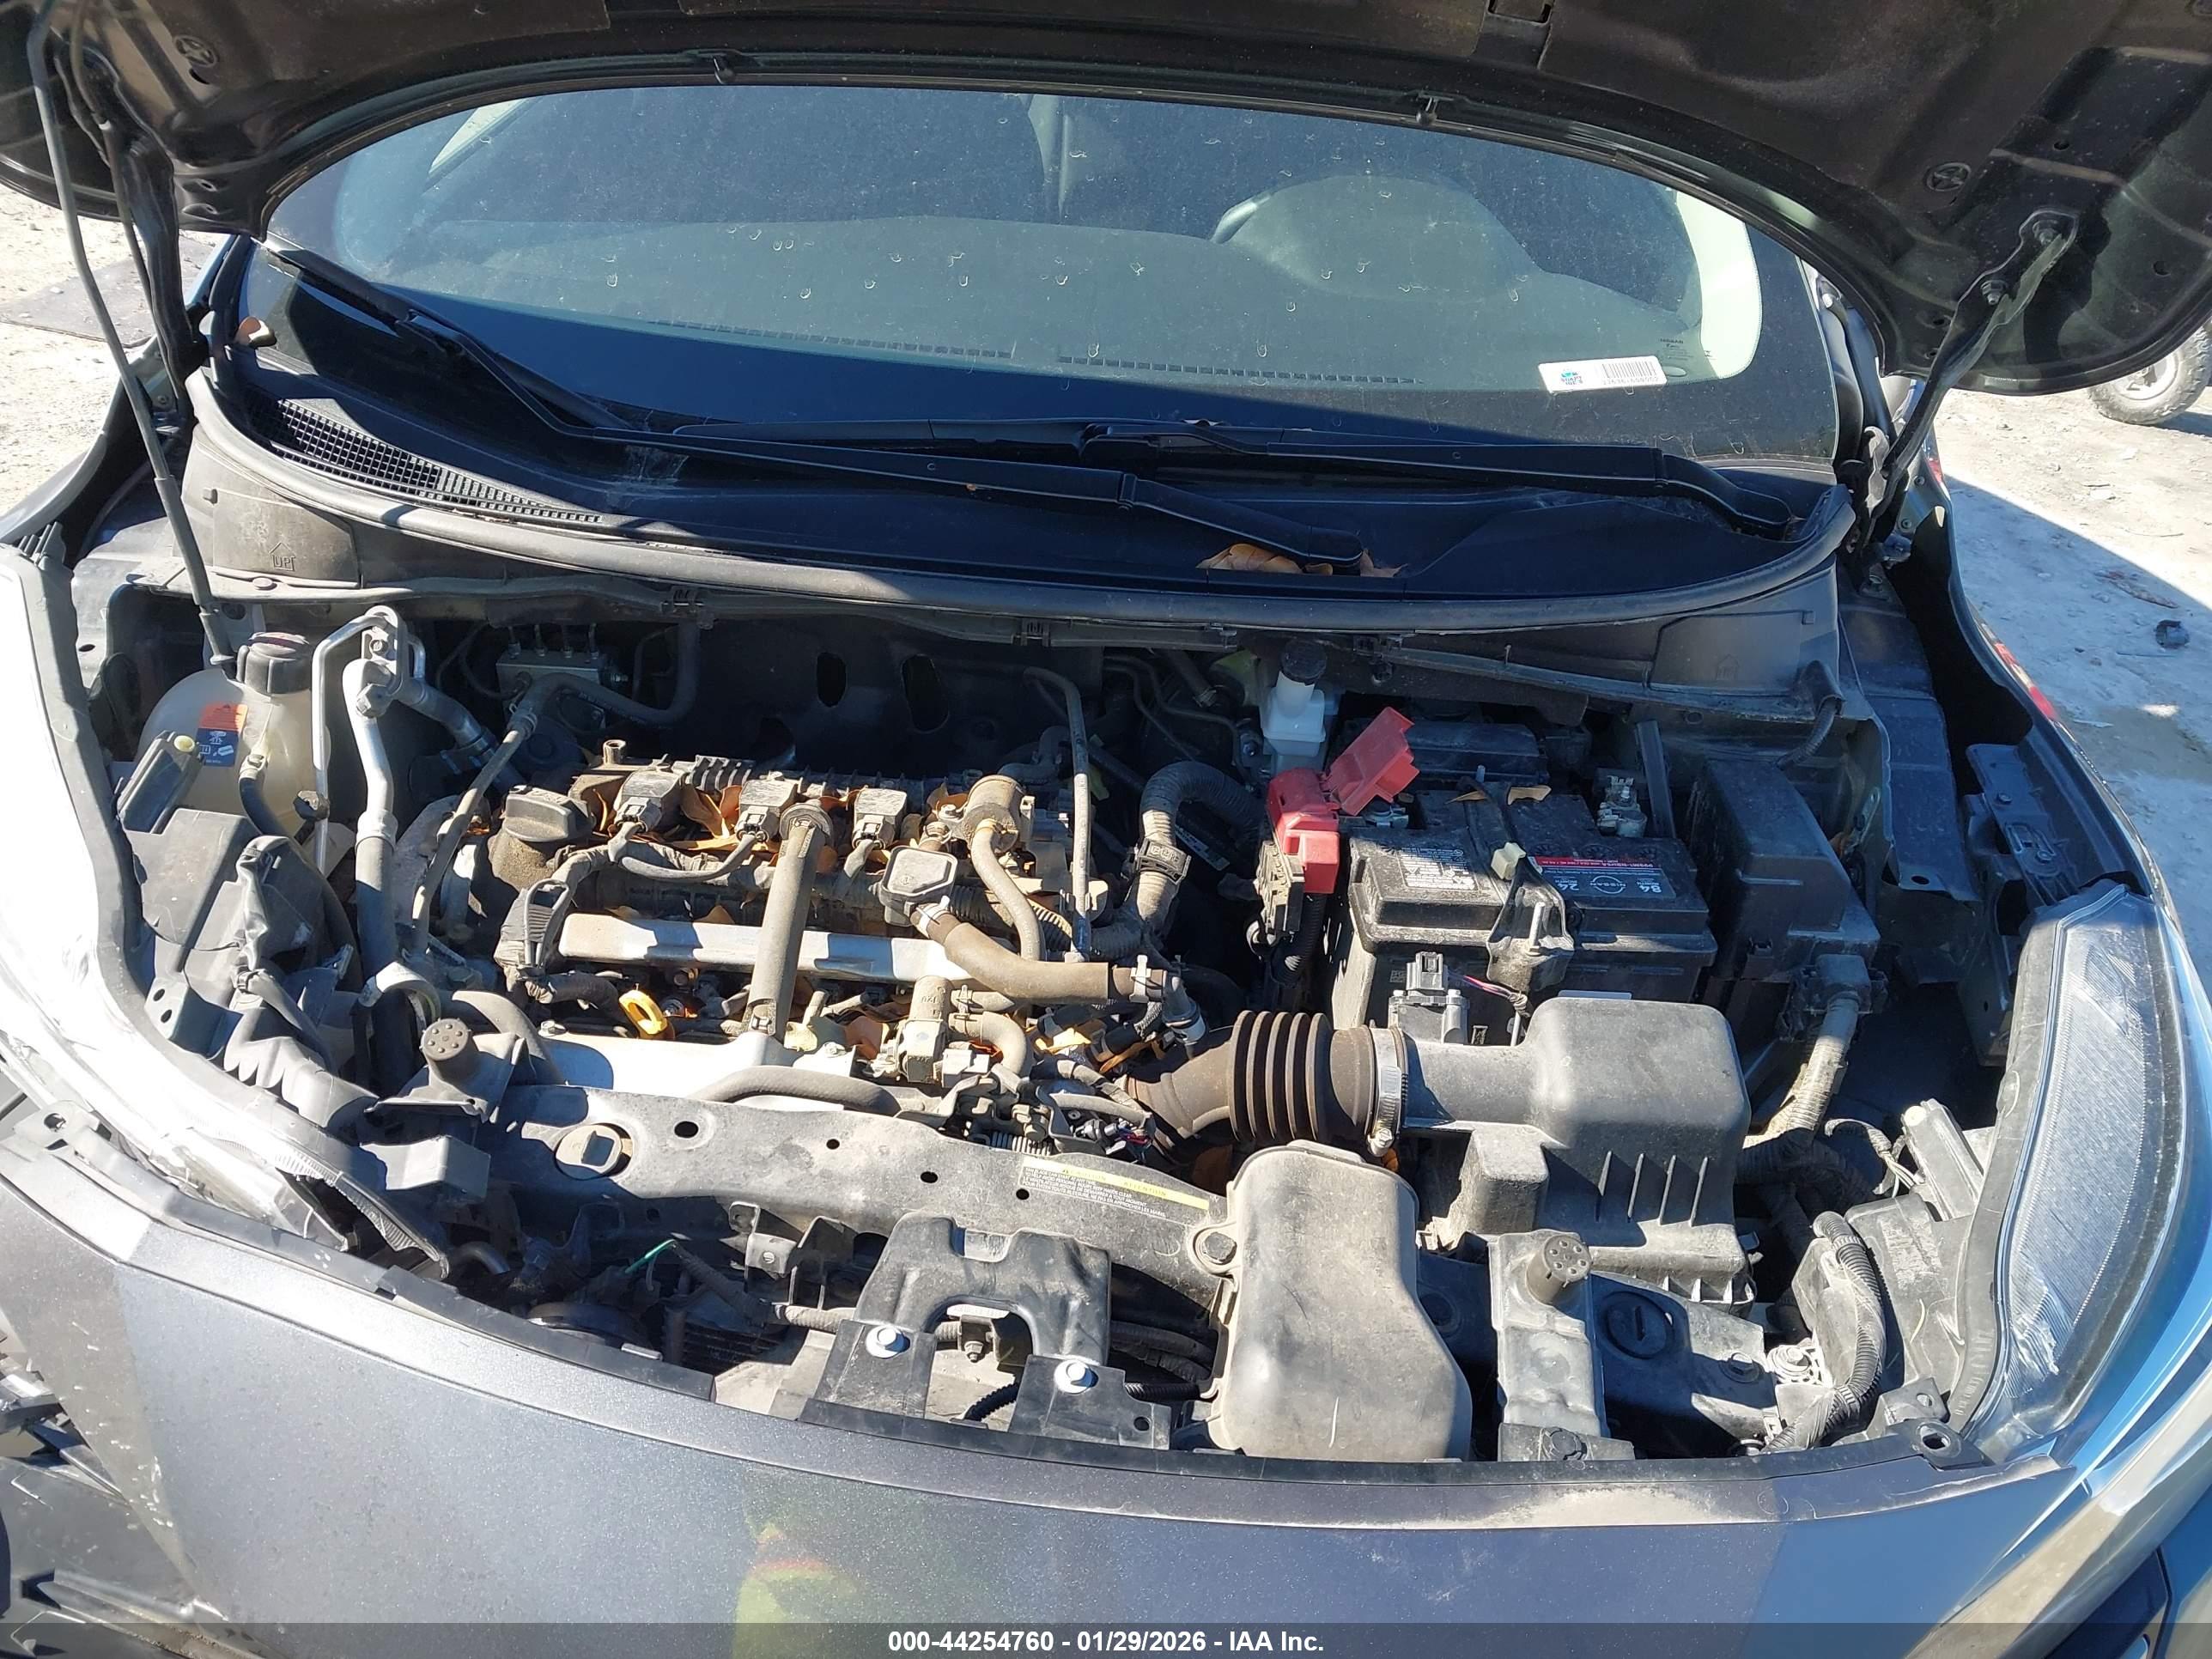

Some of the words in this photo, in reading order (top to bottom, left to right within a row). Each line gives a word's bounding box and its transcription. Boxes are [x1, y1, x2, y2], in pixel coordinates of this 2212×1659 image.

[274, 555, 292, 569] UP
[1557, 883, 1580, 891] 24
[1638, 884, 1662, 893] 84
